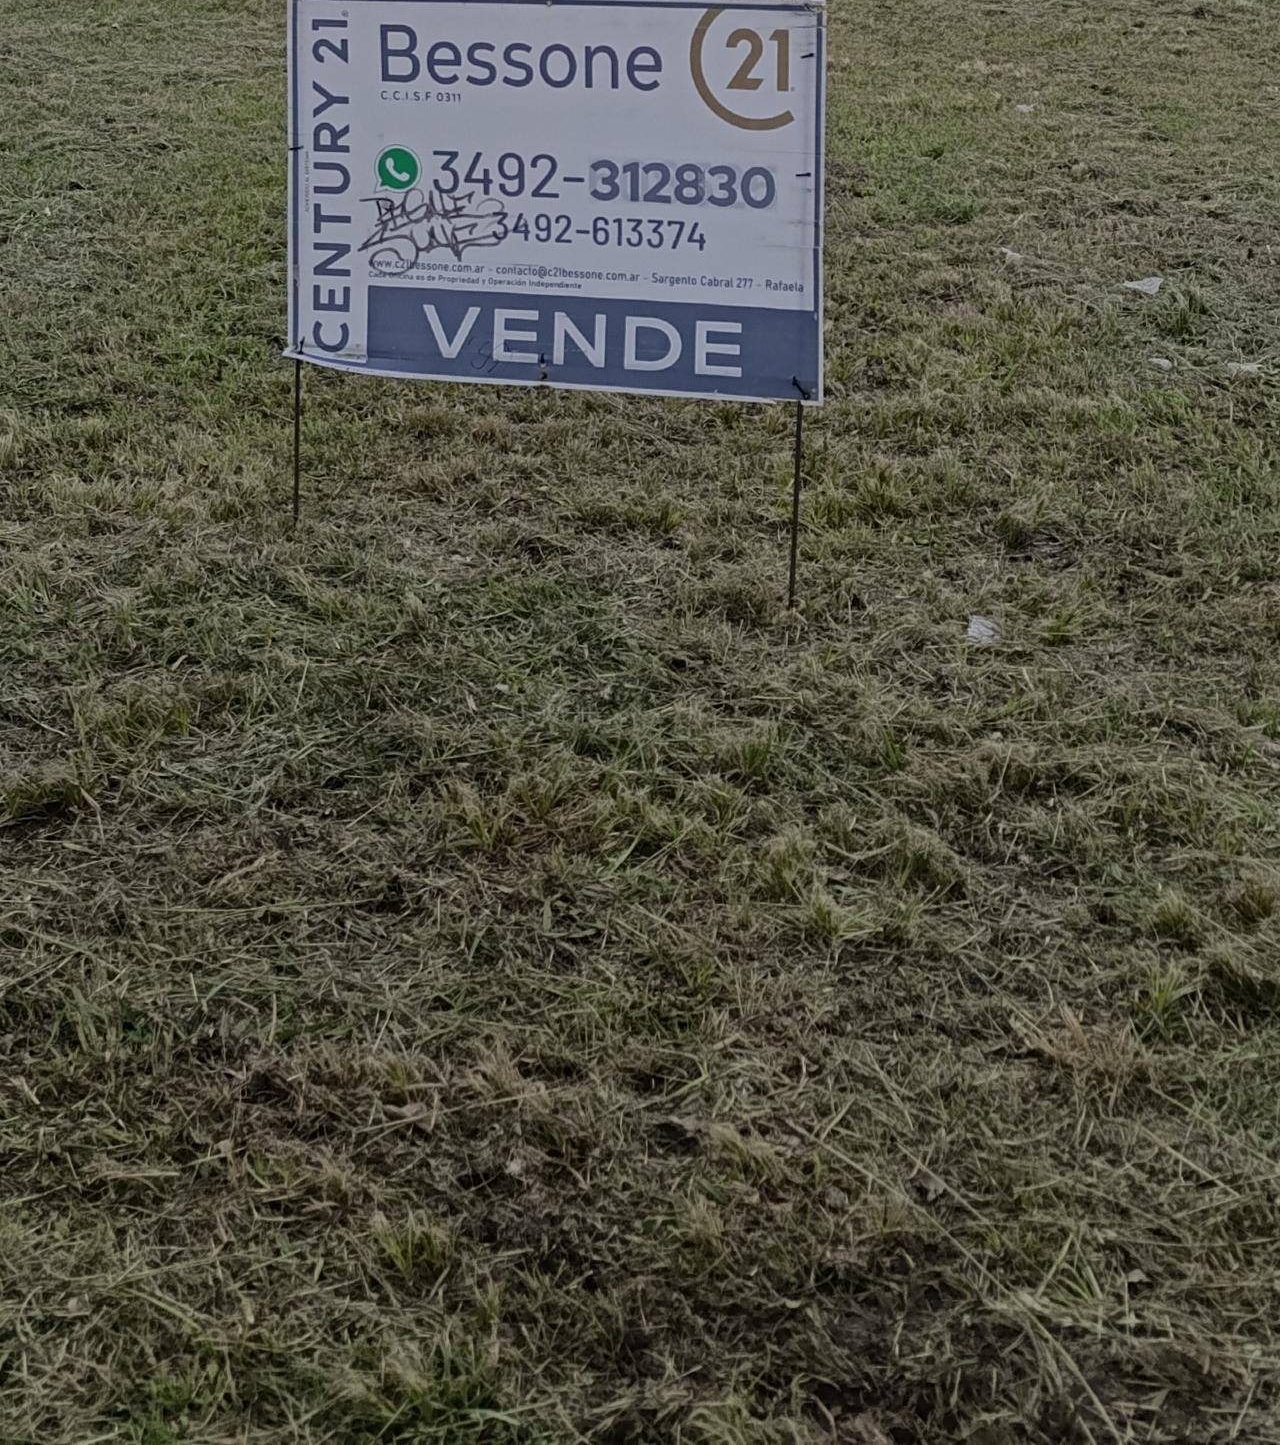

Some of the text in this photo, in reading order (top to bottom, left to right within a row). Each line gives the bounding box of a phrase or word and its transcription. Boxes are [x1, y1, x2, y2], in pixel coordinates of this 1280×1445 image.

[380, 24, 663, 92] Bessone
[436, 92, 462, 103] 0311
[312, 19, 352, 353] CENTURY 21
[433, 150, 776, 209] 3492-312830
[492, 212, 706, 251] 3492-613374
[496, 265, 640, 282] contacto@c21bessone.com.ar
[651, 272, 697, 287] Sargento
[700, 275, 733, 288] Cabral
[736, 277, 753, 289] 277
[765, 279, 805, 293] Rafaela
[529, 279, 583, 289] Independiente
[422, 304, 743, 379] VENDE
